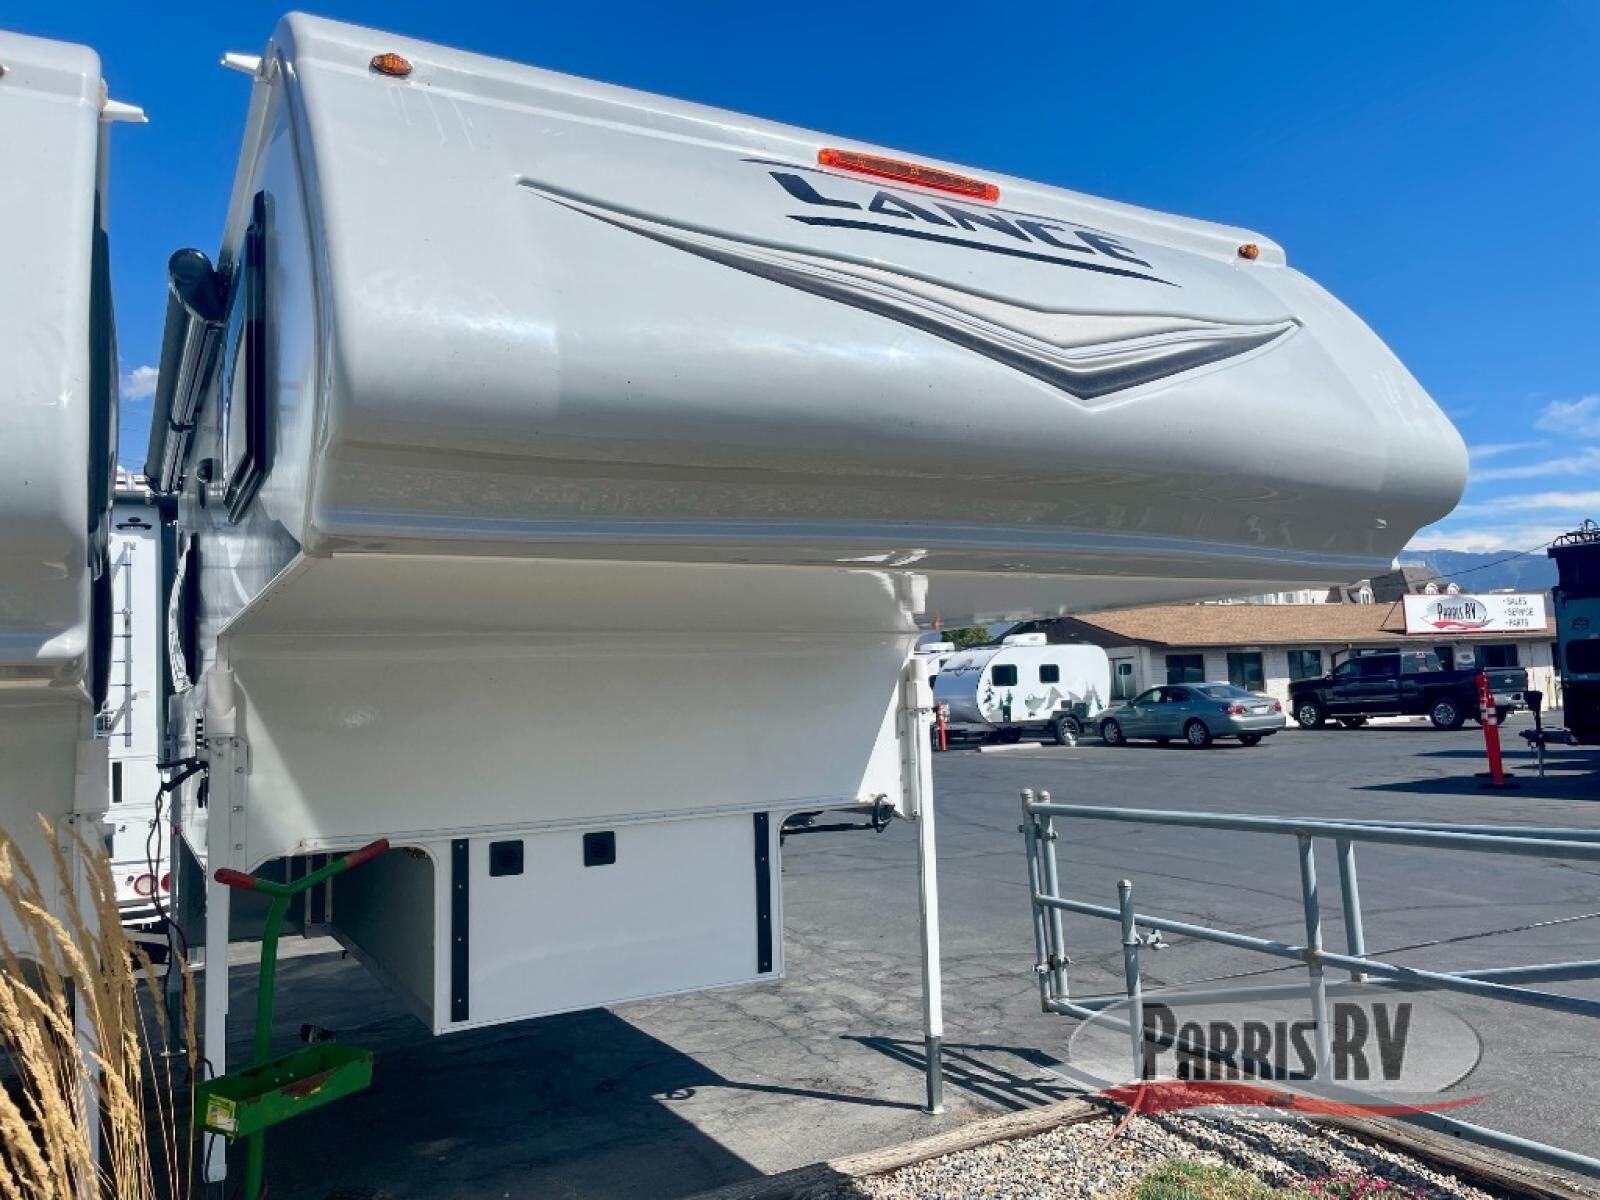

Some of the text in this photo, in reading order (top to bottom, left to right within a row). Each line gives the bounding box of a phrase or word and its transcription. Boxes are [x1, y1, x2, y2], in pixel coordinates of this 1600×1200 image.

[769, 171, 1154, 269] LANCE
[1506, 597, 1527, 605] SALES
[1465, 602, 1476, 620] RV
